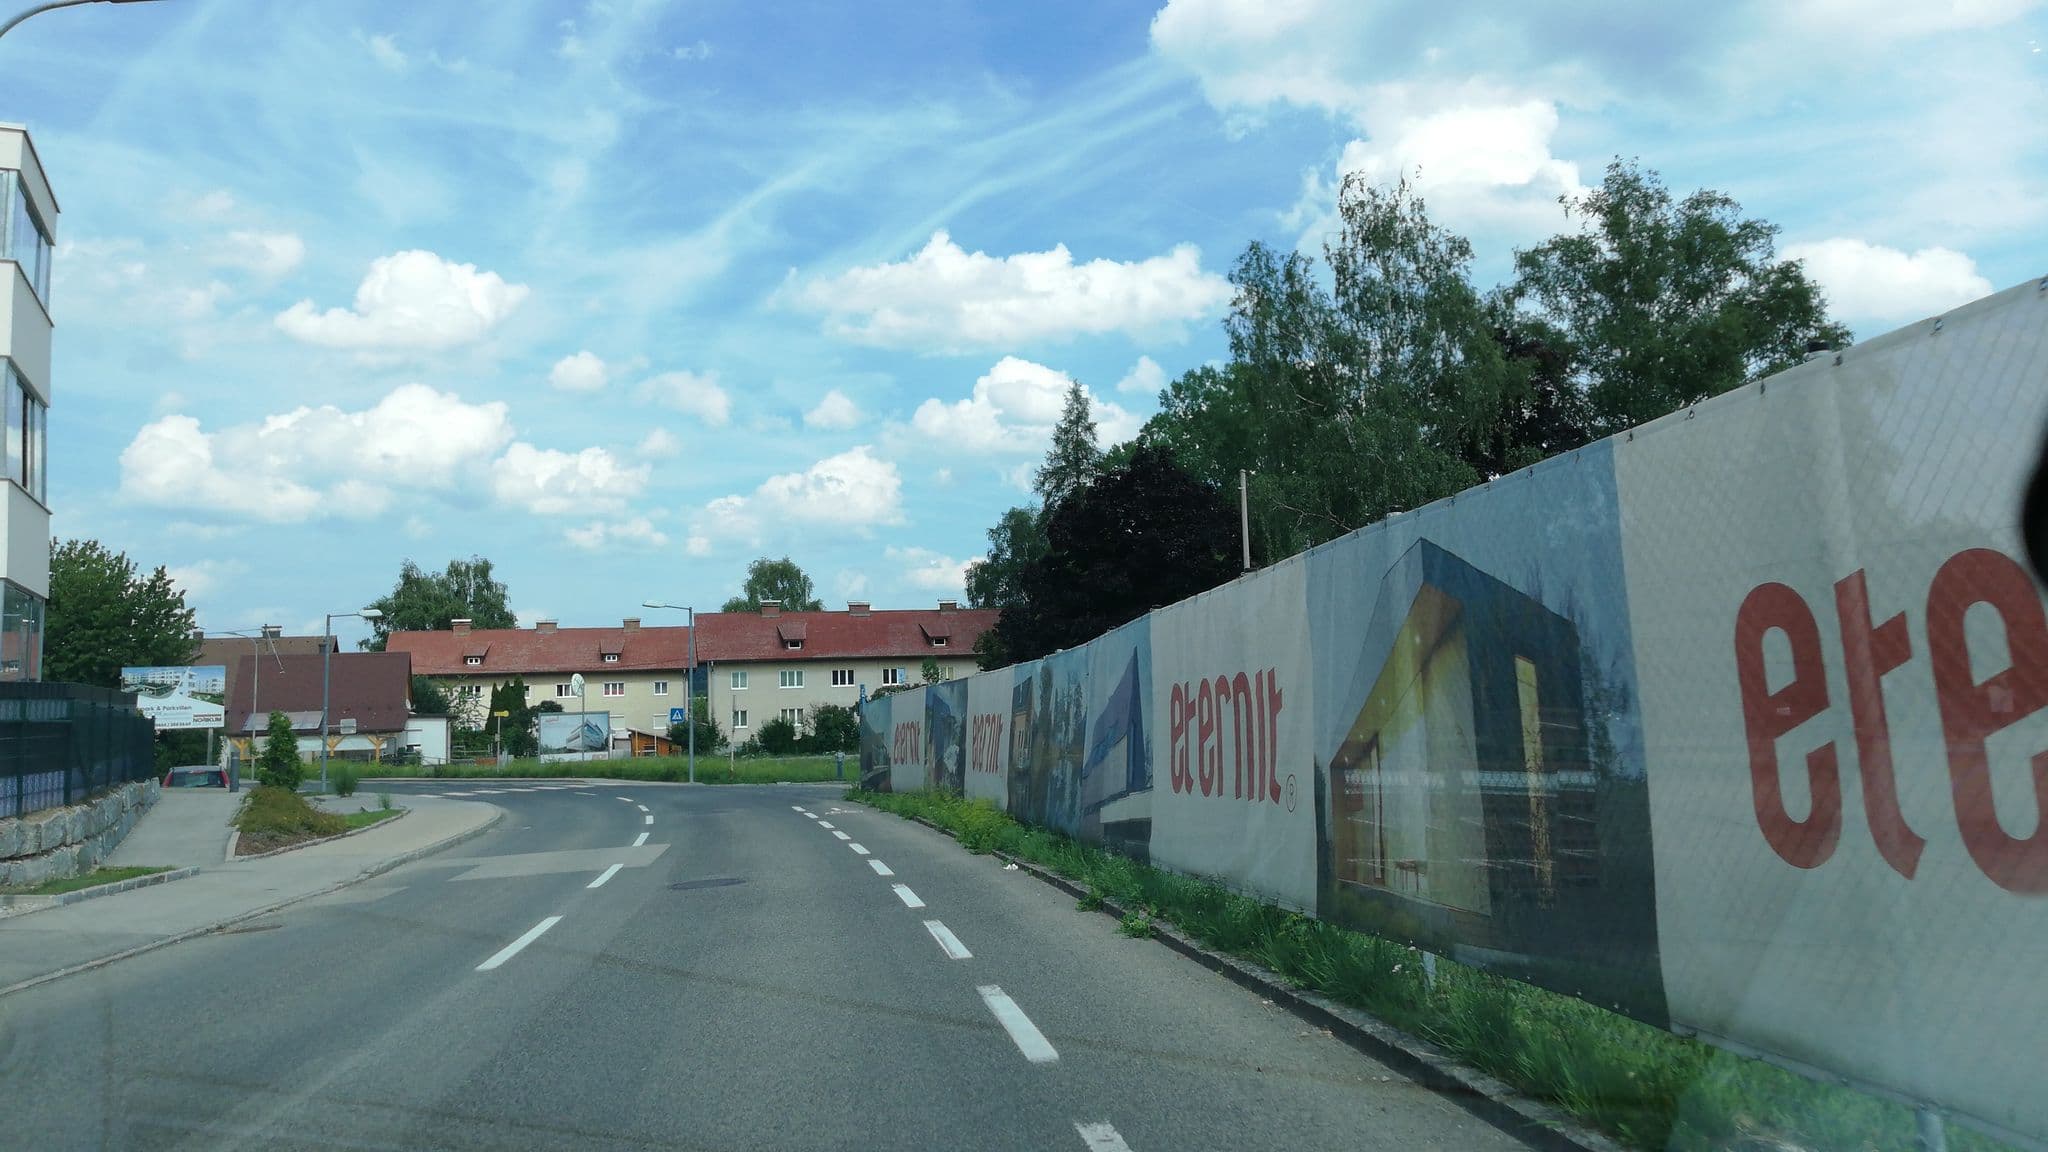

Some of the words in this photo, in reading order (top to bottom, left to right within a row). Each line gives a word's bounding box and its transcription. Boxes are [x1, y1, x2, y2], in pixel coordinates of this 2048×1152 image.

[894, 719, 921, 765] eternit
[972, 713, 1003, 774] eternit
[1170, 666, 1283, 805] eternit
